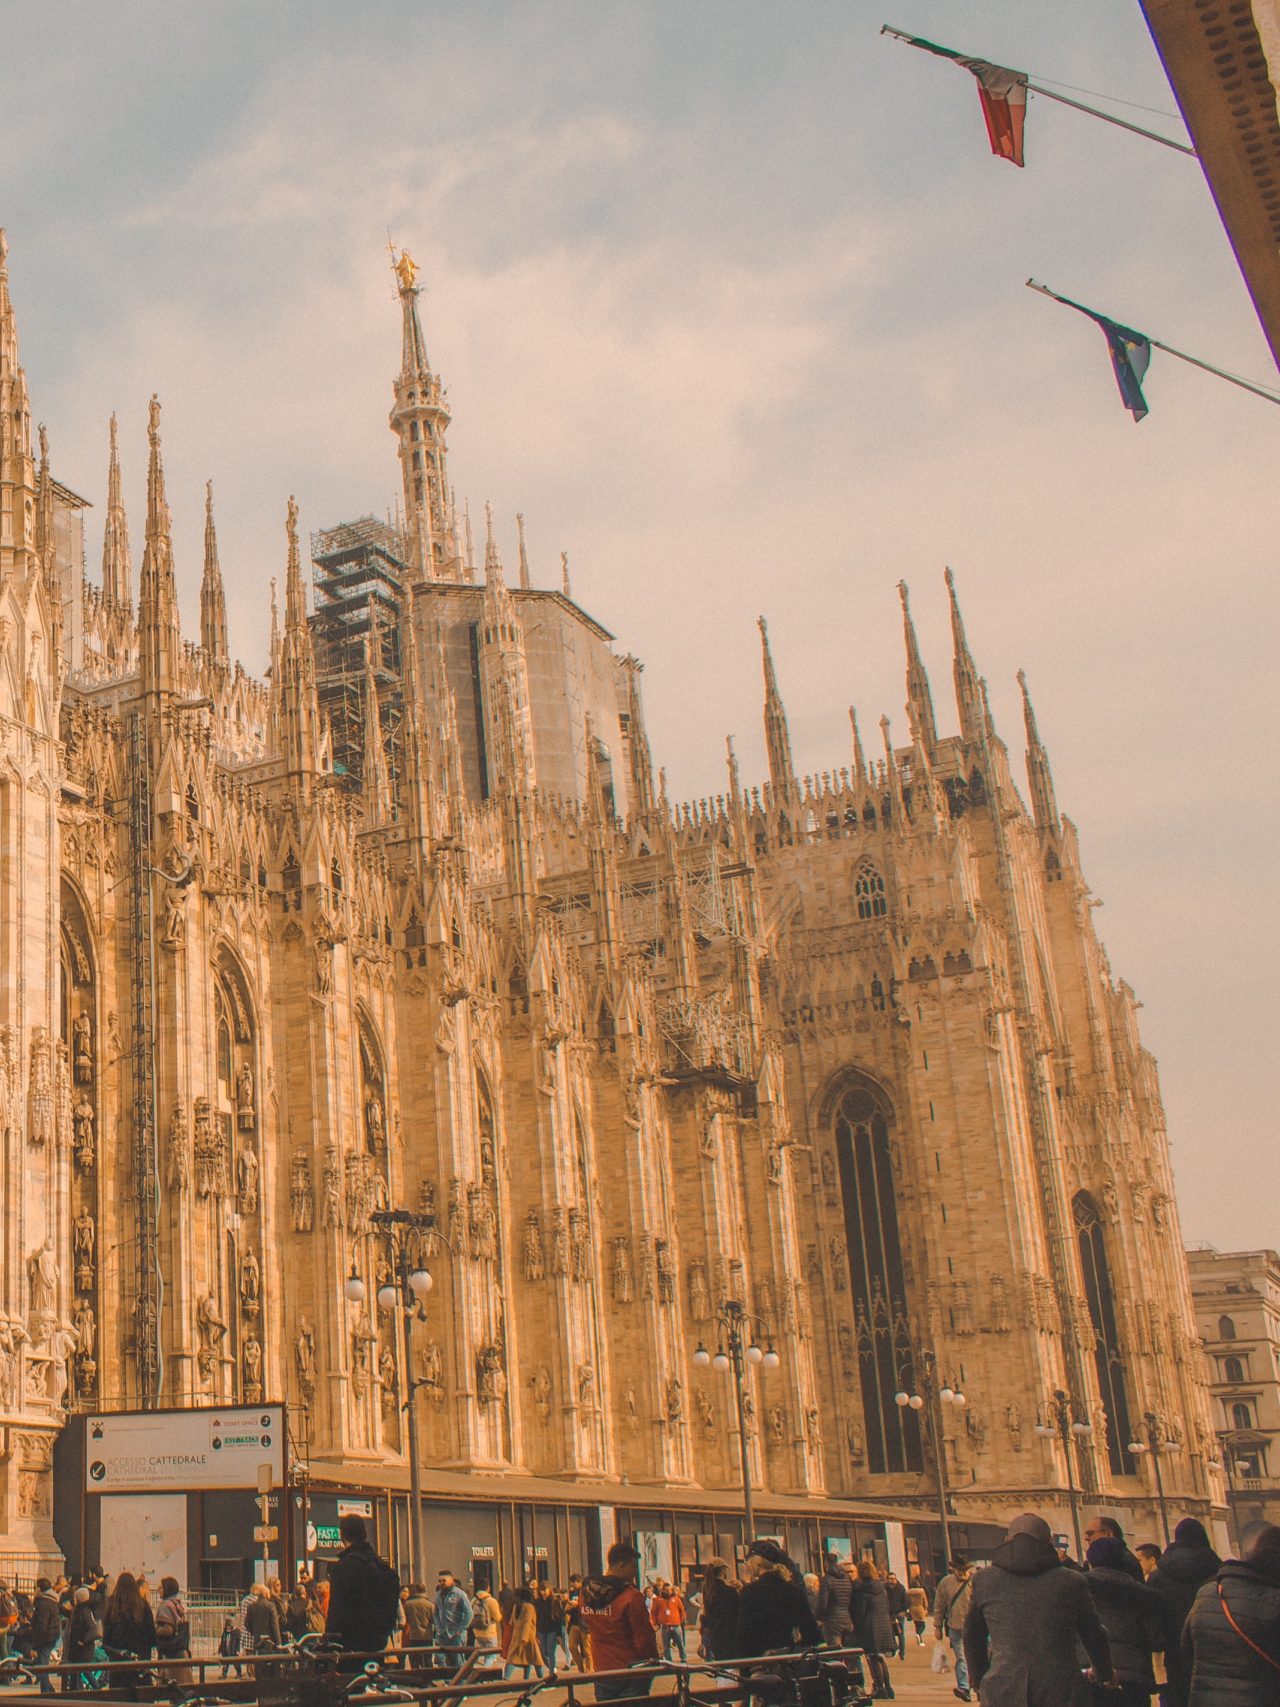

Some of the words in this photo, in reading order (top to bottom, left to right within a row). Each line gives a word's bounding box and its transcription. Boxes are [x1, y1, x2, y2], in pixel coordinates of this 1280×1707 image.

[107, 1456, 147, 1466] ACCESSO
[149, 1454, 207, 1466] CATTEDRALE
[107, 1465, 157, 1475] CATHEDRAL
[471, 1546, 495, 1557] TOILETS
[526, 1546, 548, 1556] TOLETS
[580, 1606, 595, 1616] ASK
